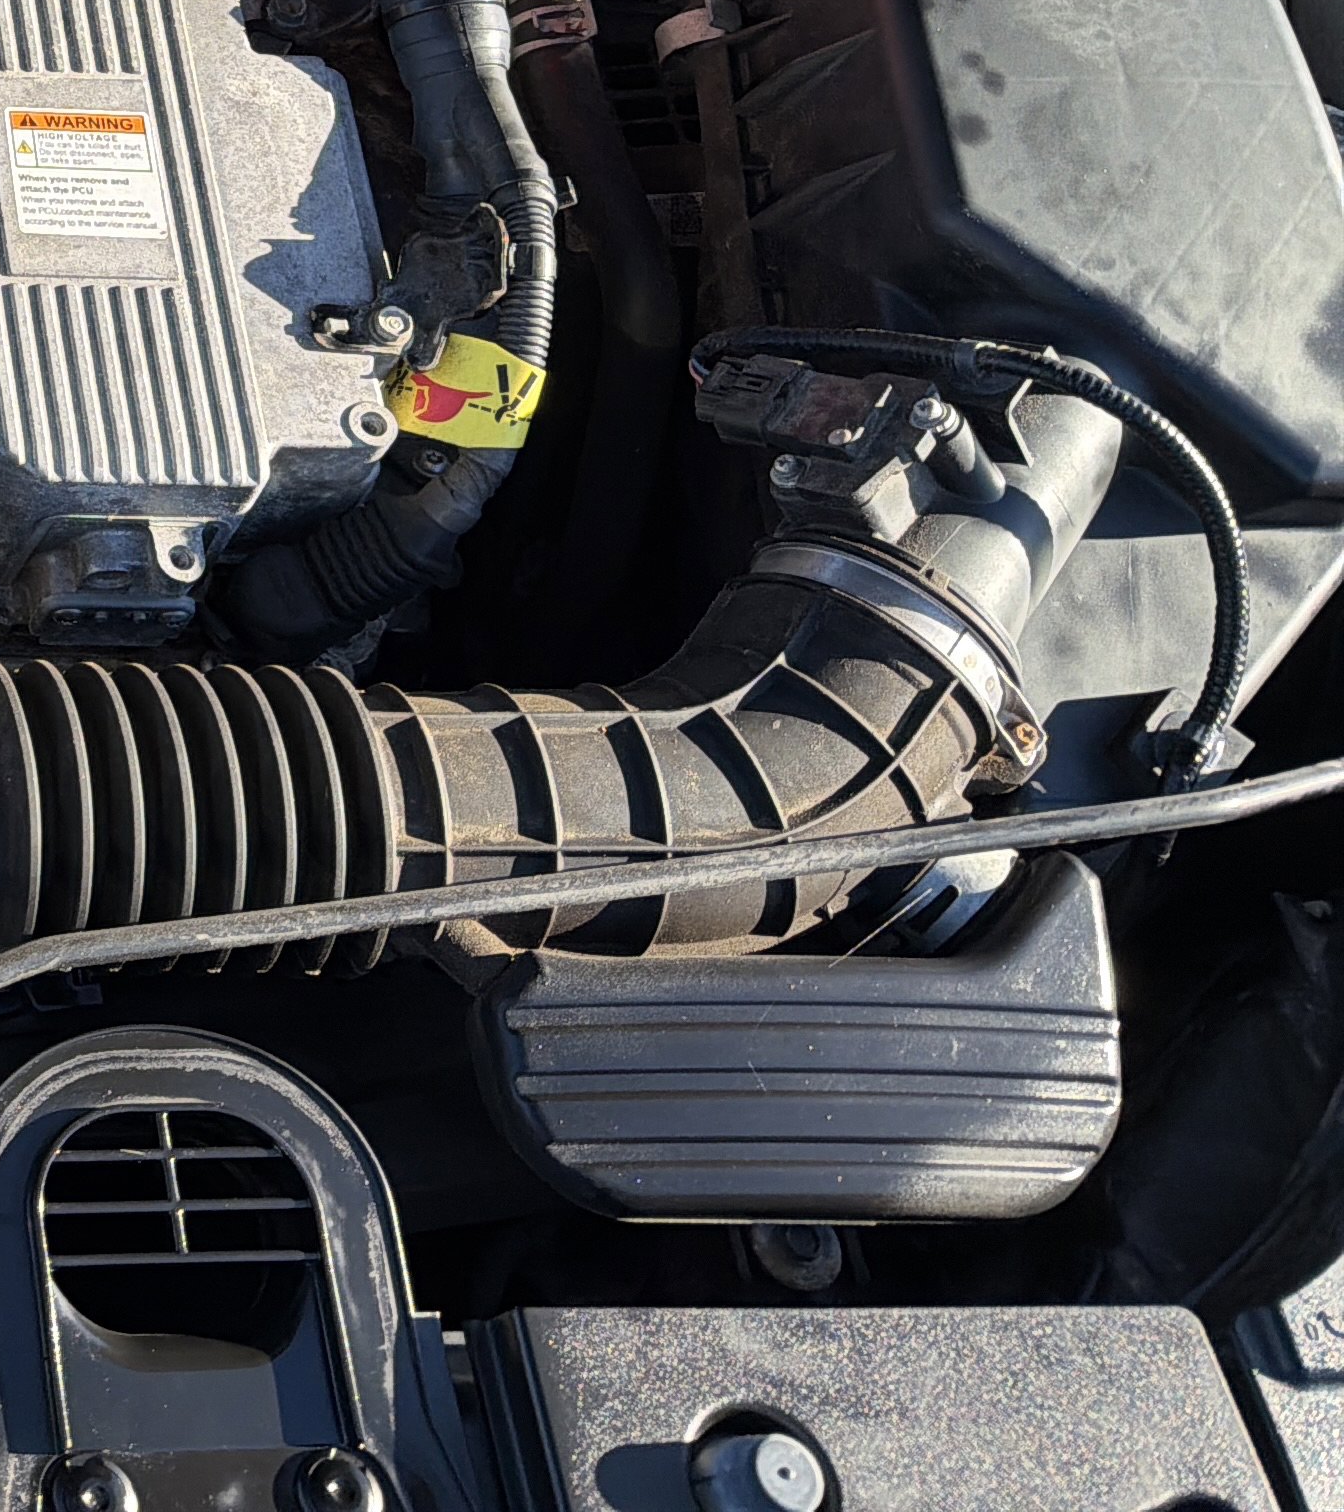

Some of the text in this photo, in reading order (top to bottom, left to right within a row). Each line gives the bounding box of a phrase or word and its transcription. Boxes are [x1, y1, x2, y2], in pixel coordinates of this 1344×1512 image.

[44, 115, 133, 130] WARNING
[38, 132, 118, 142] HIGH VOLTAGE
[19, 174, 46, 183] When
[49, 176, 67, 185] you
[53, 186, 69, 194] the
[72, 187, 93, 195] PCU
[21, 196, 46, 204] When
[49, 198, 63, 206] you
